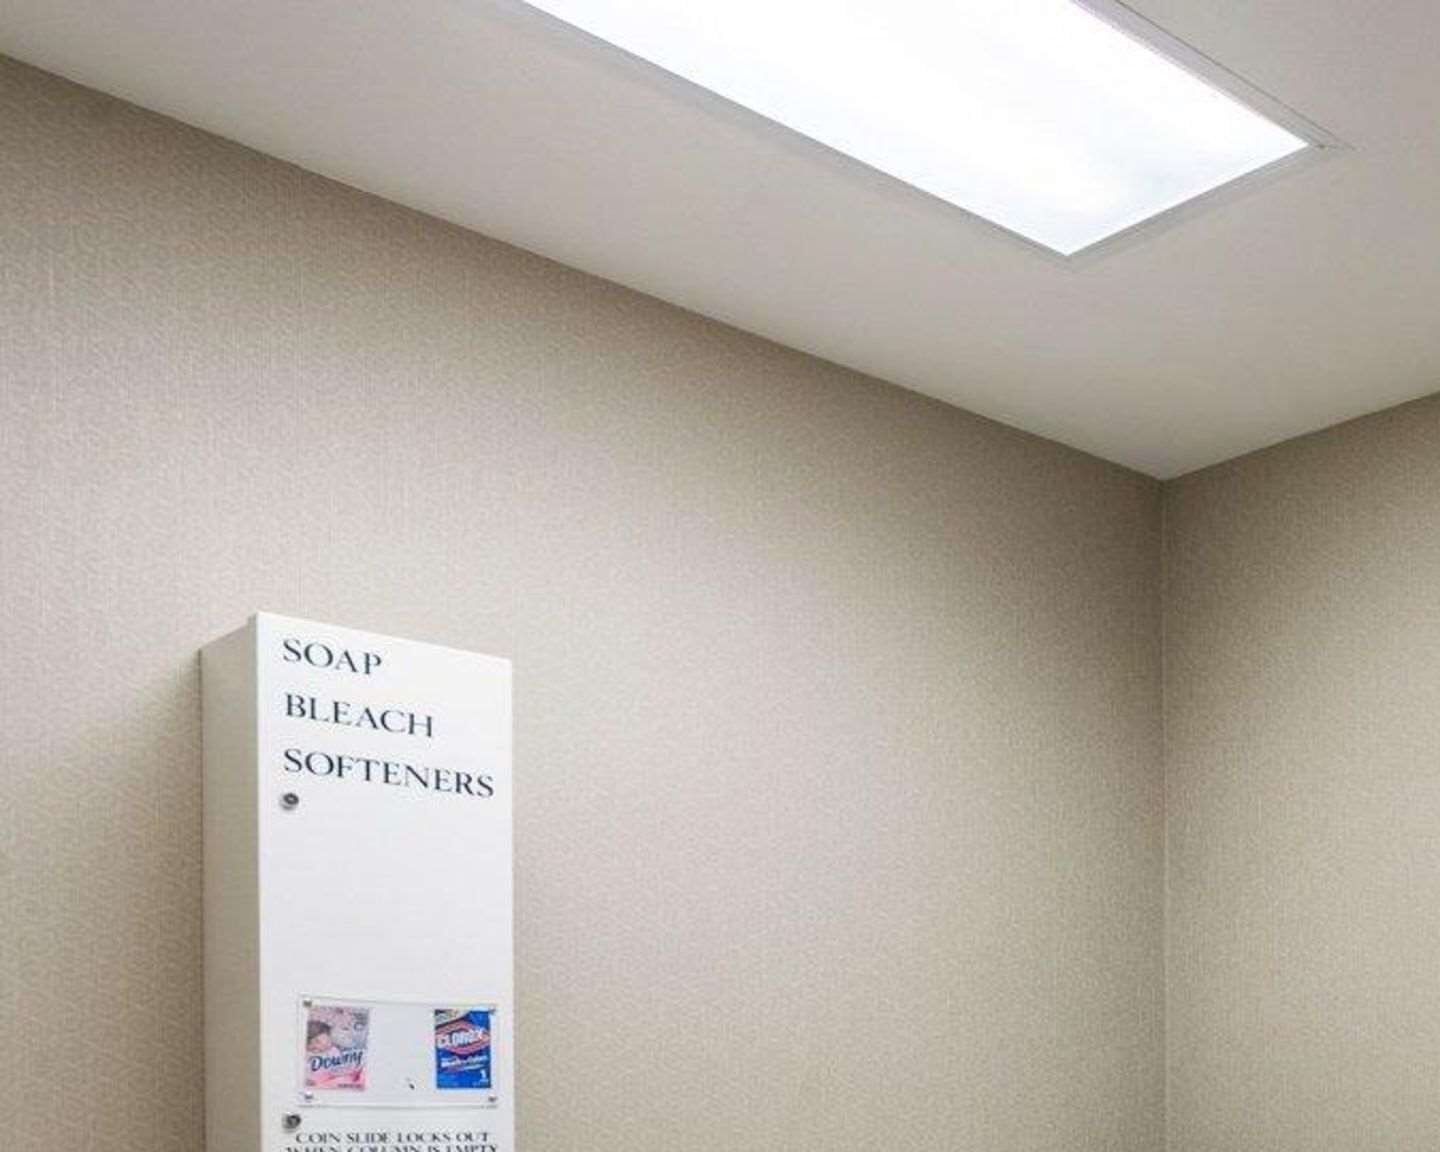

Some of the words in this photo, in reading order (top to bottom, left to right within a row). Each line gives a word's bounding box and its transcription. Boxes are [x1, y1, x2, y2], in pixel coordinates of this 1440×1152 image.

[282, 638, 382, 675] SOAP
[285, 693, 434, 738] BLEACH
[284, 749, 495, 798] SOFTENERS
[311, 1051, 364, 1072] Downy
[296, 1132, 341, 1144] COIN
[348, 1132, 389, 1144] SLIDE
[398, 1132, 450, 1144] LOCKS
[456, 1132, 488, 1142] OUT
